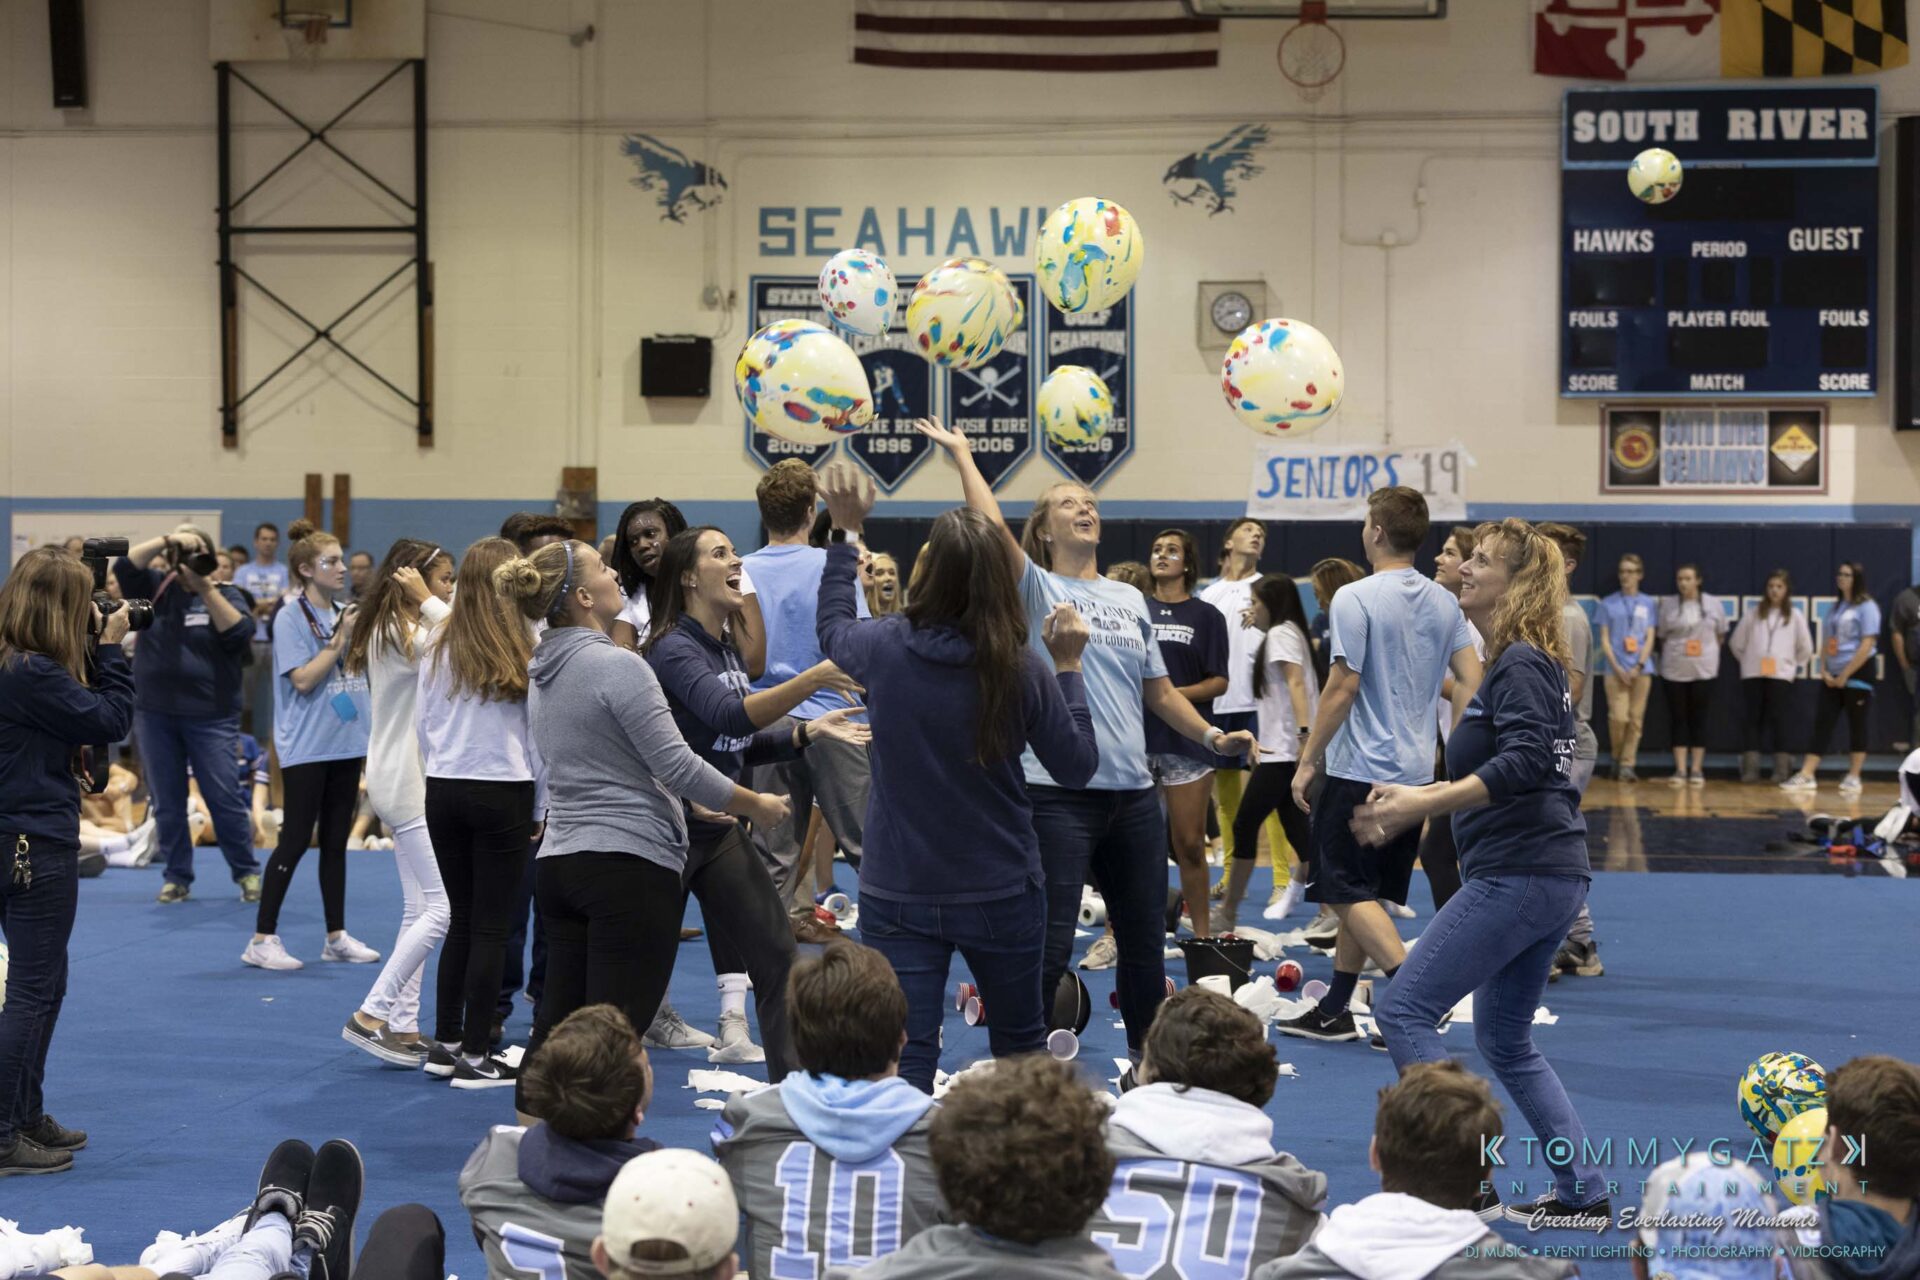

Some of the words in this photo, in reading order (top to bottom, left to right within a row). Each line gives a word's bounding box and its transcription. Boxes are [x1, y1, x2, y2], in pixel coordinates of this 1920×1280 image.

[1573, 110, 1699, 142] SOUTH
[1728, 109, 1868, 140] RIVER
[759, 207, 1047, 256] SEAHAW
[1573, 230, 1654, 252] HAWKS
[1788, 227, 1863, 251] GUEST
[1691, 241, 1747, 257] PERIOD
[1569, 311, 1618, 327] FOULS
[1668, 311, 1726, 327] PLAYER
[1730, 311, 1770, 327] FOUL
[1819, 310, 1870, 327] FOULS
[1050, 331, 1126, 355] CHAMPION
[1569, 375, 1618, 391] SCORE
[1690, 375, 1745, 391] MATCH
[1819, 373, 1870, 390] SCORE
[868, 438, 912, 453] 1996
[1257, 454, 1402, 498] SENIORS
[770, 1142, 904, 1280] 10
[1090, 1159, 1266, 1280] 50
